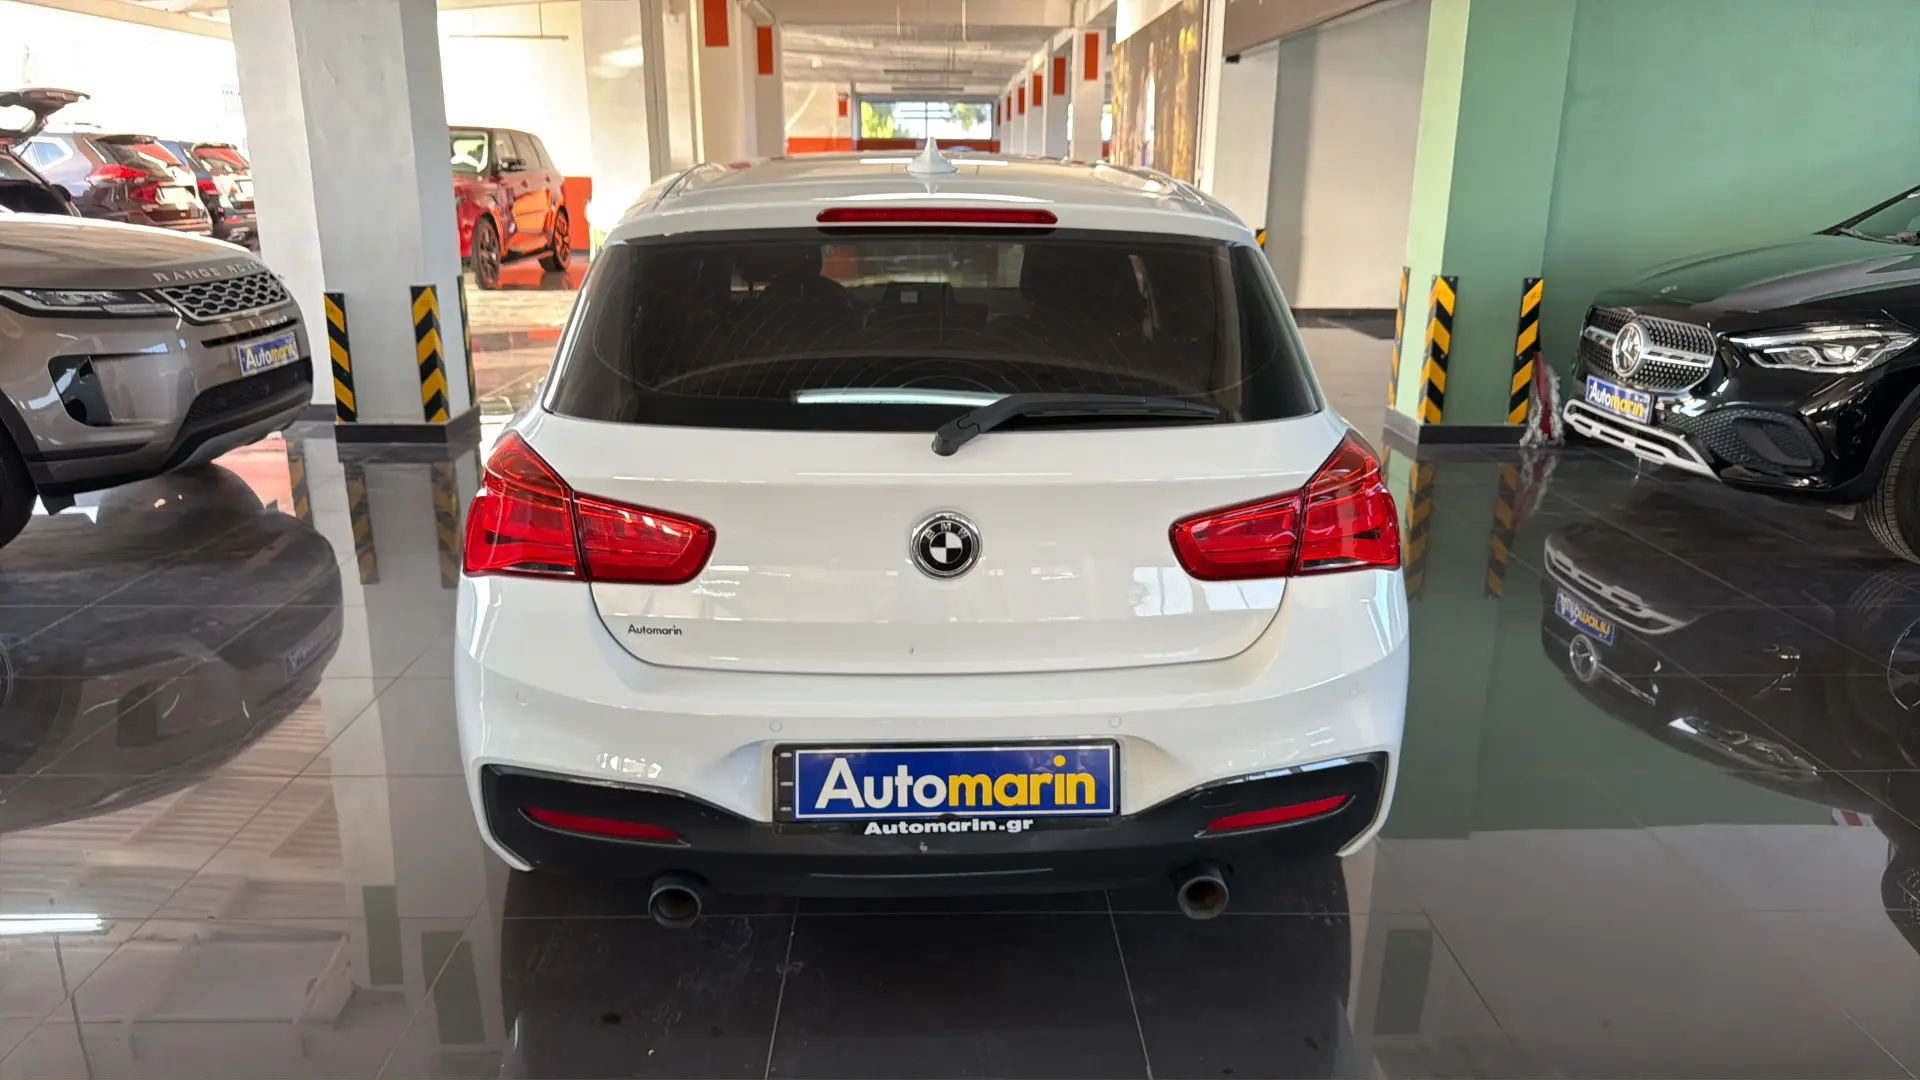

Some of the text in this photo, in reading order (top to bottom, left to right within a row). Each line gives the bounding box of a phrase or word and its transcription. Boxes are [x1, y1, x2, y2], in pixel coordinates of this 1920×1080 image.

[152, 267, 221, 283] RANGE
[1589, 381, 1645, 417] Automarin
[924, 522, 969, 540] BMW
[627, 624, 682, 636] Automarin
[815, 755, 1096, 809] Automarin
[864, 818, 1034, 836] Automarin.gr
